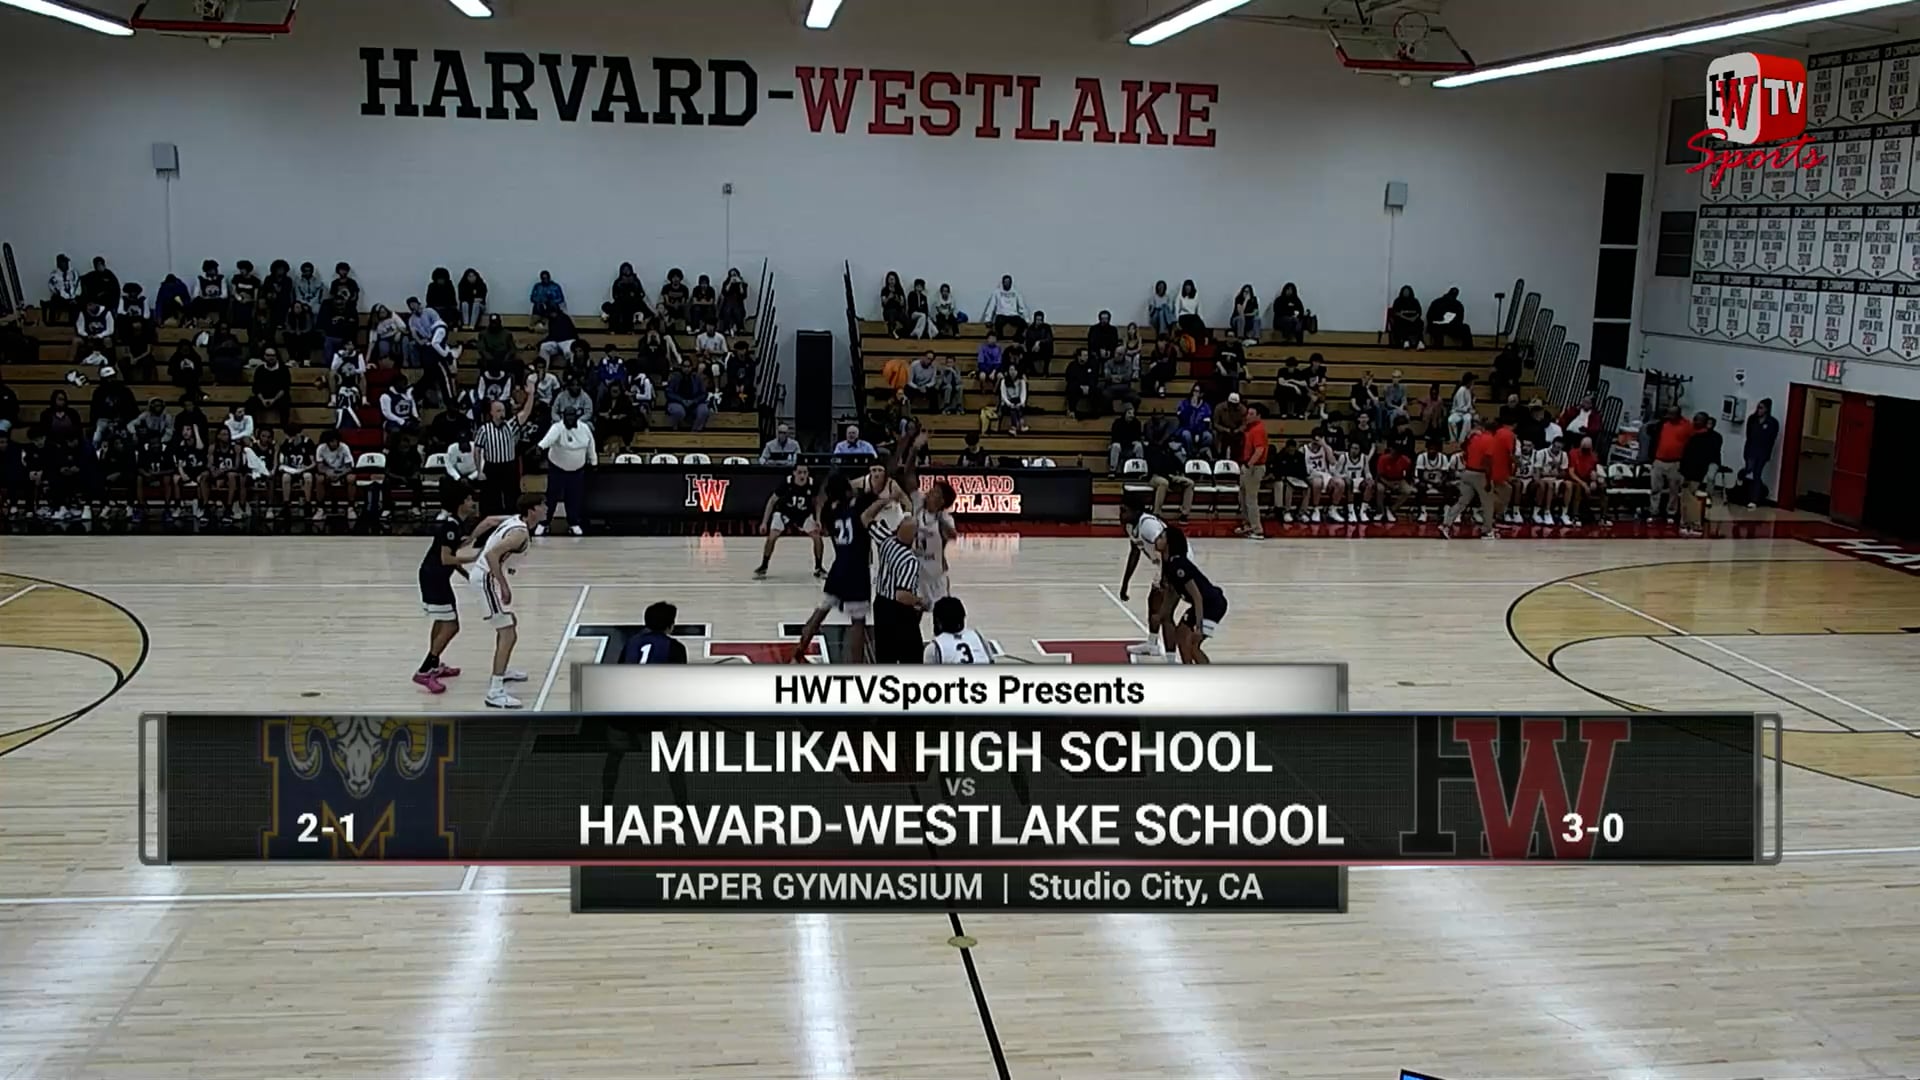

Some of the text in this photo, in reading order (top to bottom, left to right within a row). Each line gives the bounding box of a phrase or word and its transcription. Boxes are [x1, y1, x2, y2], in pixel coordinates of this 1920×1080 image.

[359, 46, 1219, 147] HARVARD-WESTLAKE
[685, 474, 730, 513] HW
[919, 475, 1015, 494] HRVARD
[638, 644, 652, 664] 1
[957, 642, 974, 664] 3
